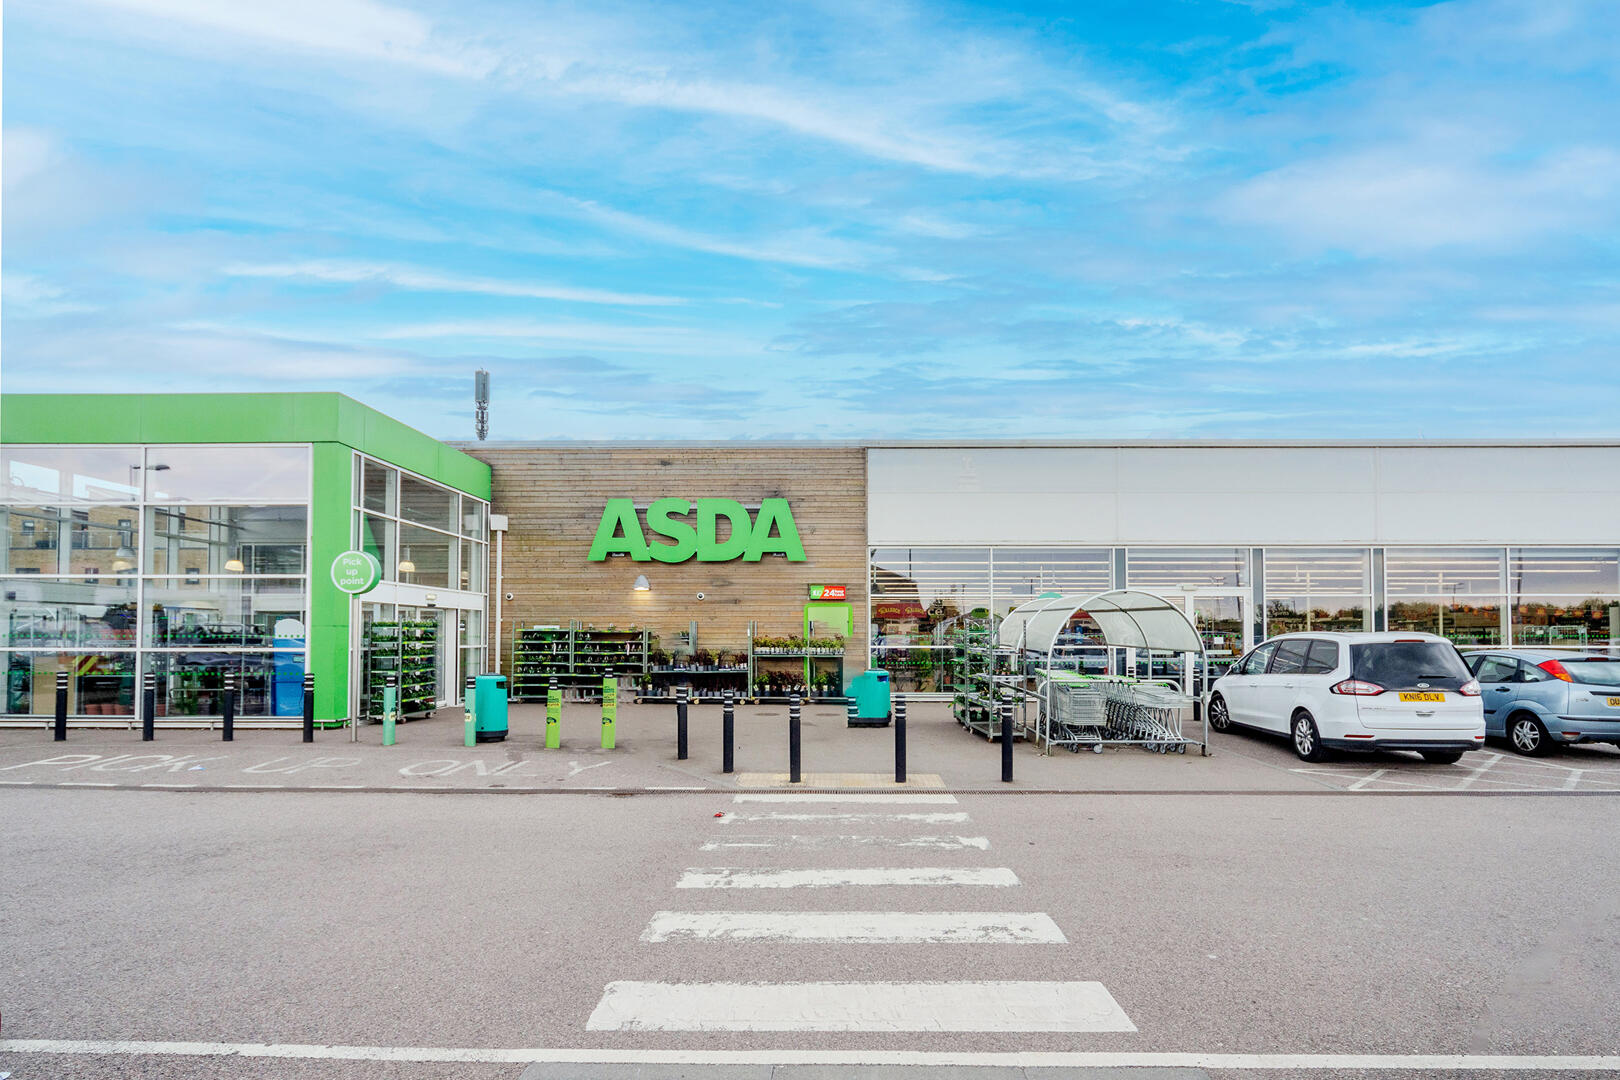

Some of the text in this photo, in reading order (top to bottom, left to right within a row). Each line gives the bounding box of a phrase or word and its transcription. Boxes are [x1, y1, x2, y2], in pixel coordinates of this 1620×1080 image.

[586, 496, 808, 564] ASDA
[343, 558, 362, 566] Pick
[340, 577, 364, 585] point
[823, 589, 835, 597] 24
[1403, 693, 1440, 702] KN16 DLV
[0, 754, 612, 777] PICK UP ONLY
